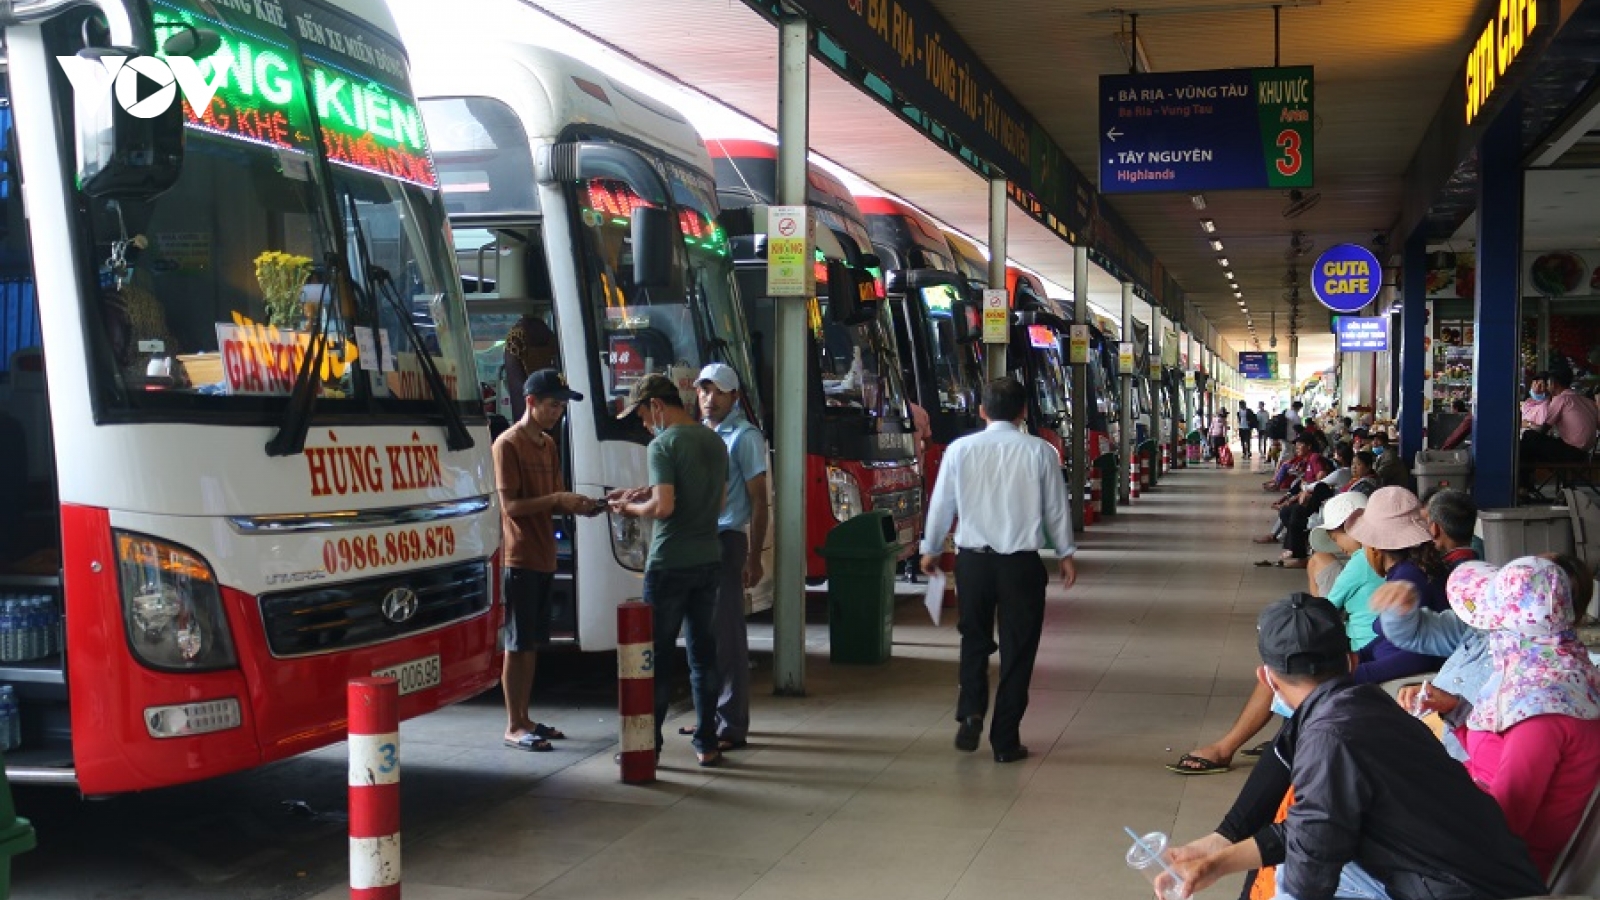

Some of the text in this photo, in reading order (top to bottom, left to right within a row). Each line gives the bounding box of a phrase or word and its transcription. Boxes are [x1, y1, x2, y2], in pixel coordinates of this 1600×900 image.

[1466, 19, 1495, 125] GUTA
[1118, 87, 1138, 102] BÀ
[1141, 88, 1165, 104] RỊA
[1175, 84, 1217, 99] VŨNG
[1221, 82, 1249, 98] TÀU
[1258, 80, 1282, 104] KHU
[314, 68, 422, 150] KIÊN
[1117, 148, 1213, 164] TÂY NGUYÊN
[1275, 129, 1302, 176] 3
[1117, 168, 1175, 183] Highlands
[1323, 260, 1370, 277] GUTA
[1324, 278, 1370, 294] CAFE
[304, 430, 443, 496] HÙNG KIÊN
[322, 525, 456, 574] 0986.869.879
[640, 650, 654, 671] 3
[378, 742, 398, 774] 3
